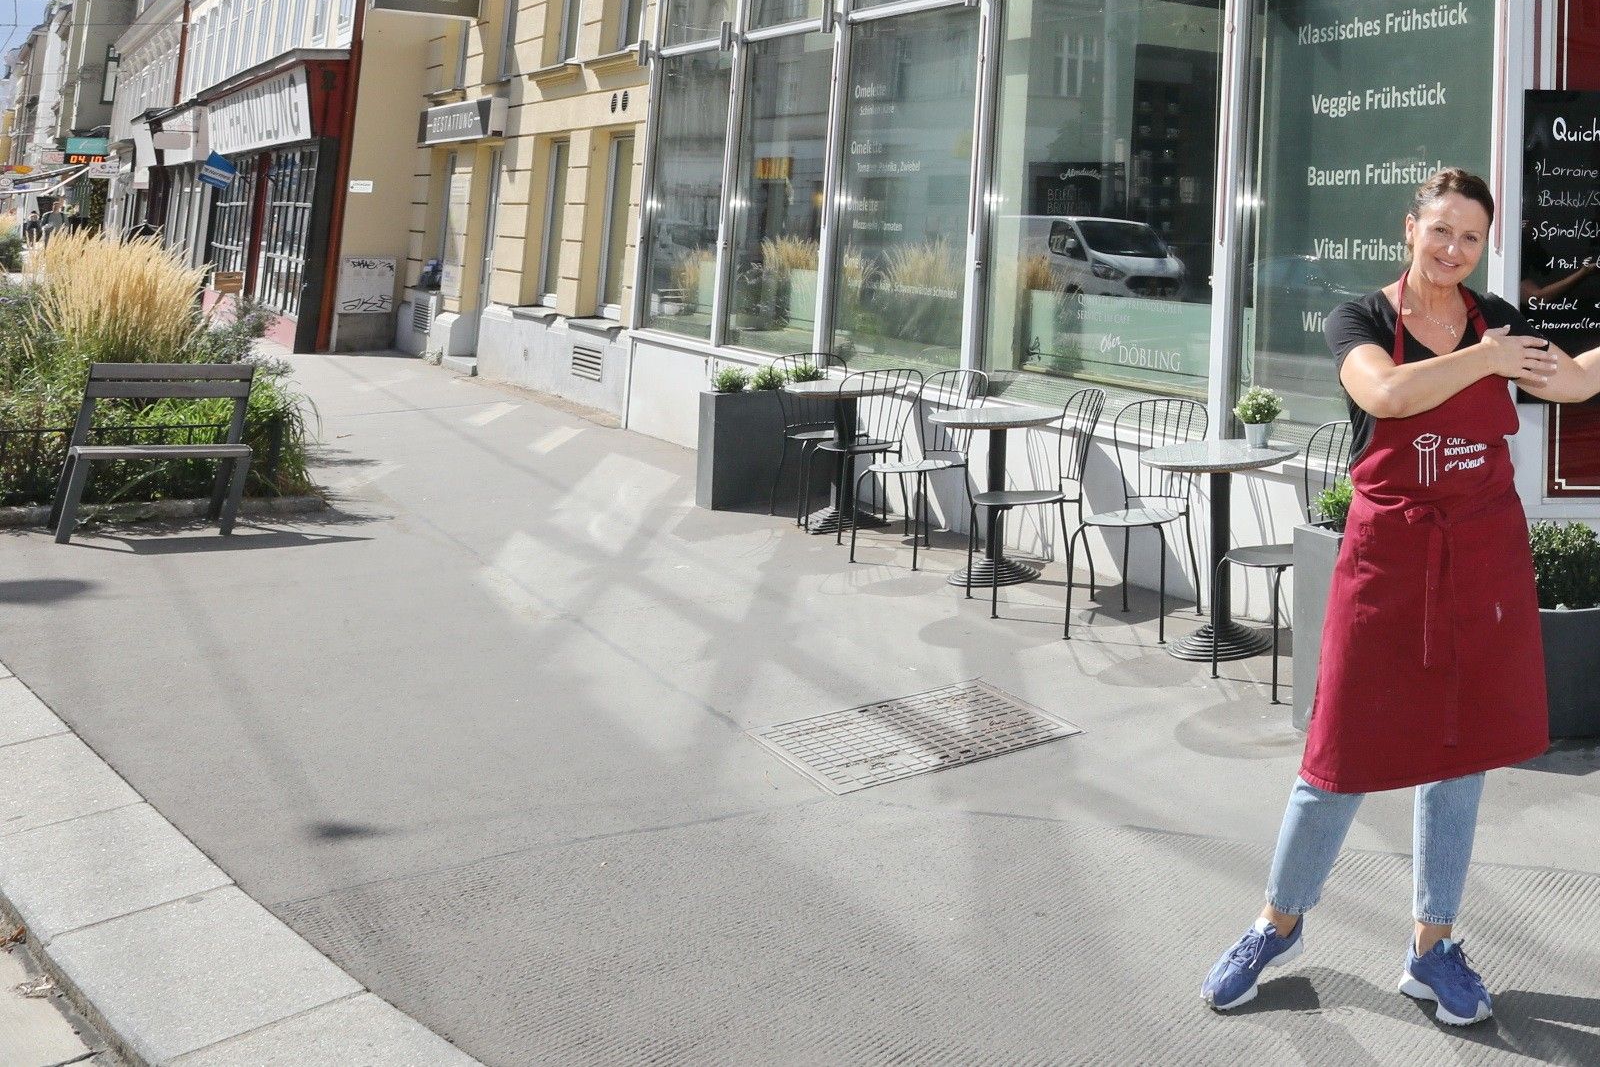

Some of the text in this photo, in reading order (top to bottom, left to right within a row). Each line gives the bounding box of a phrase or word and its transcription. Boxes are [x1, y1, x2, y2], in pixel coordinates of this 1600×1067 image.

[1298, 1, 1468, 46] Klassisches Frühstück
[1311, 81, 1447, 119] Veggie Frühstück
[211, 72, 302, 151] BUCHHANDLUNG
[432, 112, 474, 133] BESTATTUNG
[1307, 165, 1361, 187] Bauern
[1542, 158, 1599, 178] Lorraine
[1313, 237, 1349, 260] Vital
[1546, 256, 1554, 269] 1
[1557, 256, 1579, 270] Port.
[1582, 256, 1593, 268] €
[1528, 296, 1579, 311] Strudel
[1118, 343, 1182, 372] DÖBLING
[1446, 437, 1467, 445] CAFE
